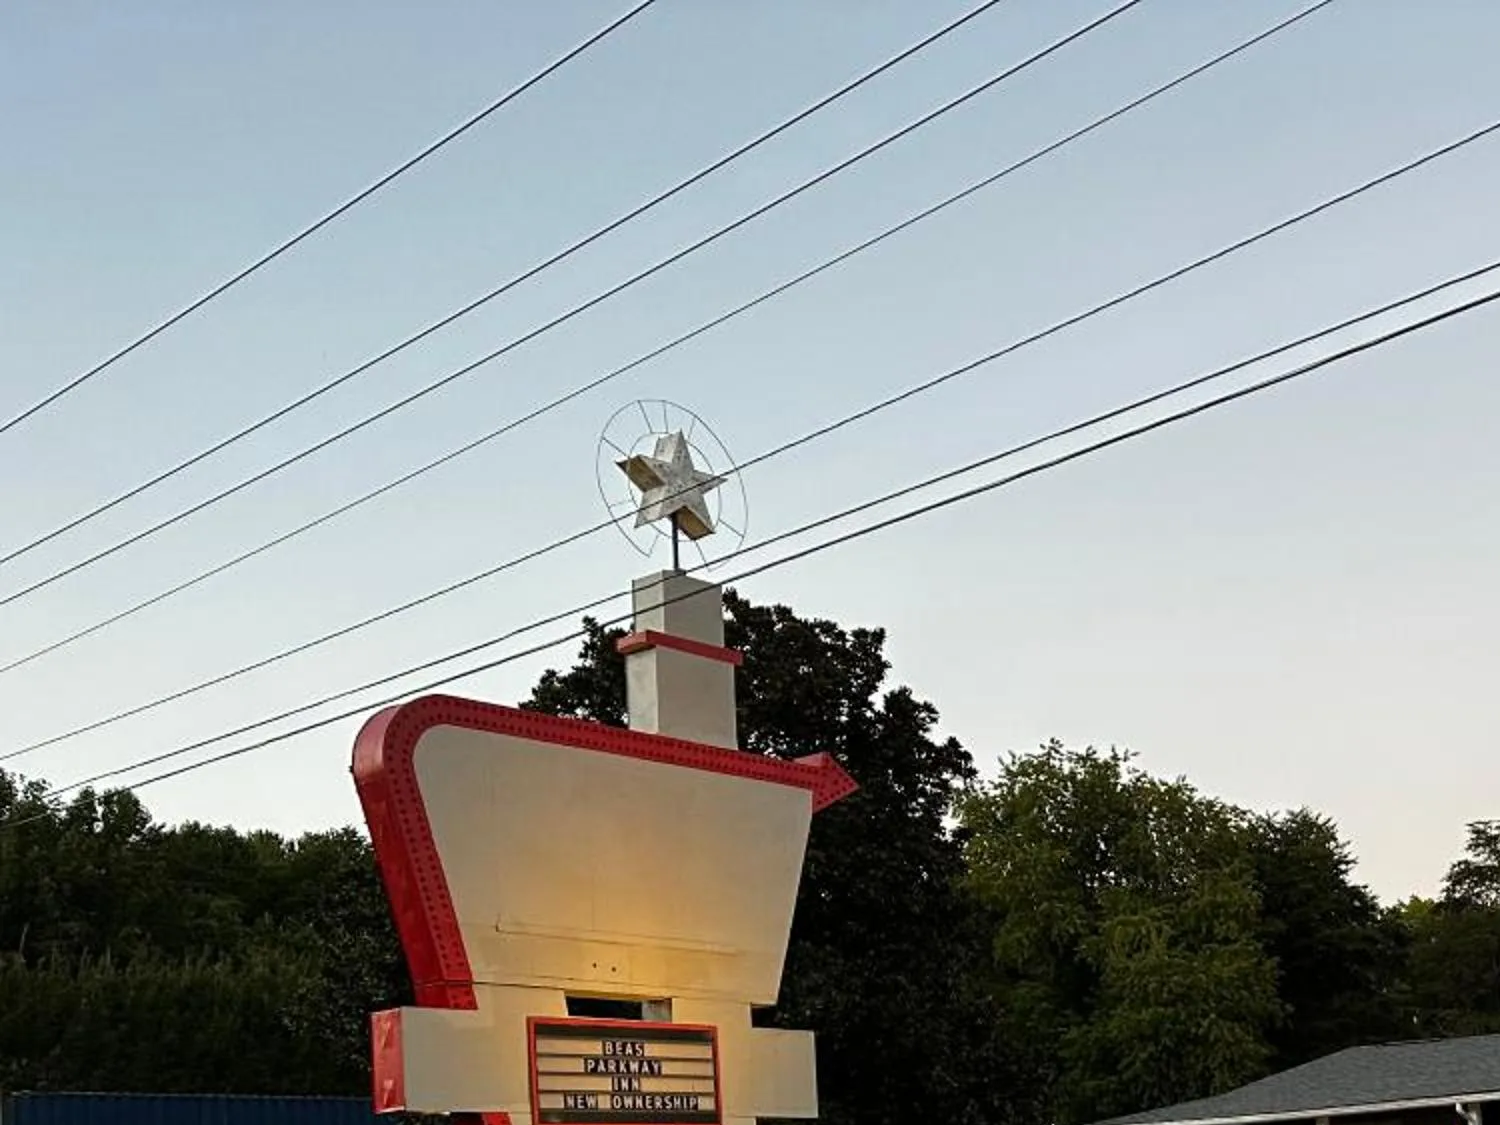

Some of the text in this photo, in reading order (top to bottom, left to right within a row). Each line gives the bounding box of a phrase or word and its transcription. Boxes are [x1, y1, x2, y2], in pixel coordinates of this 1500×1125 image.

[605, 1040, 643, 1057] BEAS
[587, 1059, 660, 1076] PARKWAY
[614, 1076, 639, 1091] INN
[566, 1094, 699, 1111] NEW OWNERSHIP
